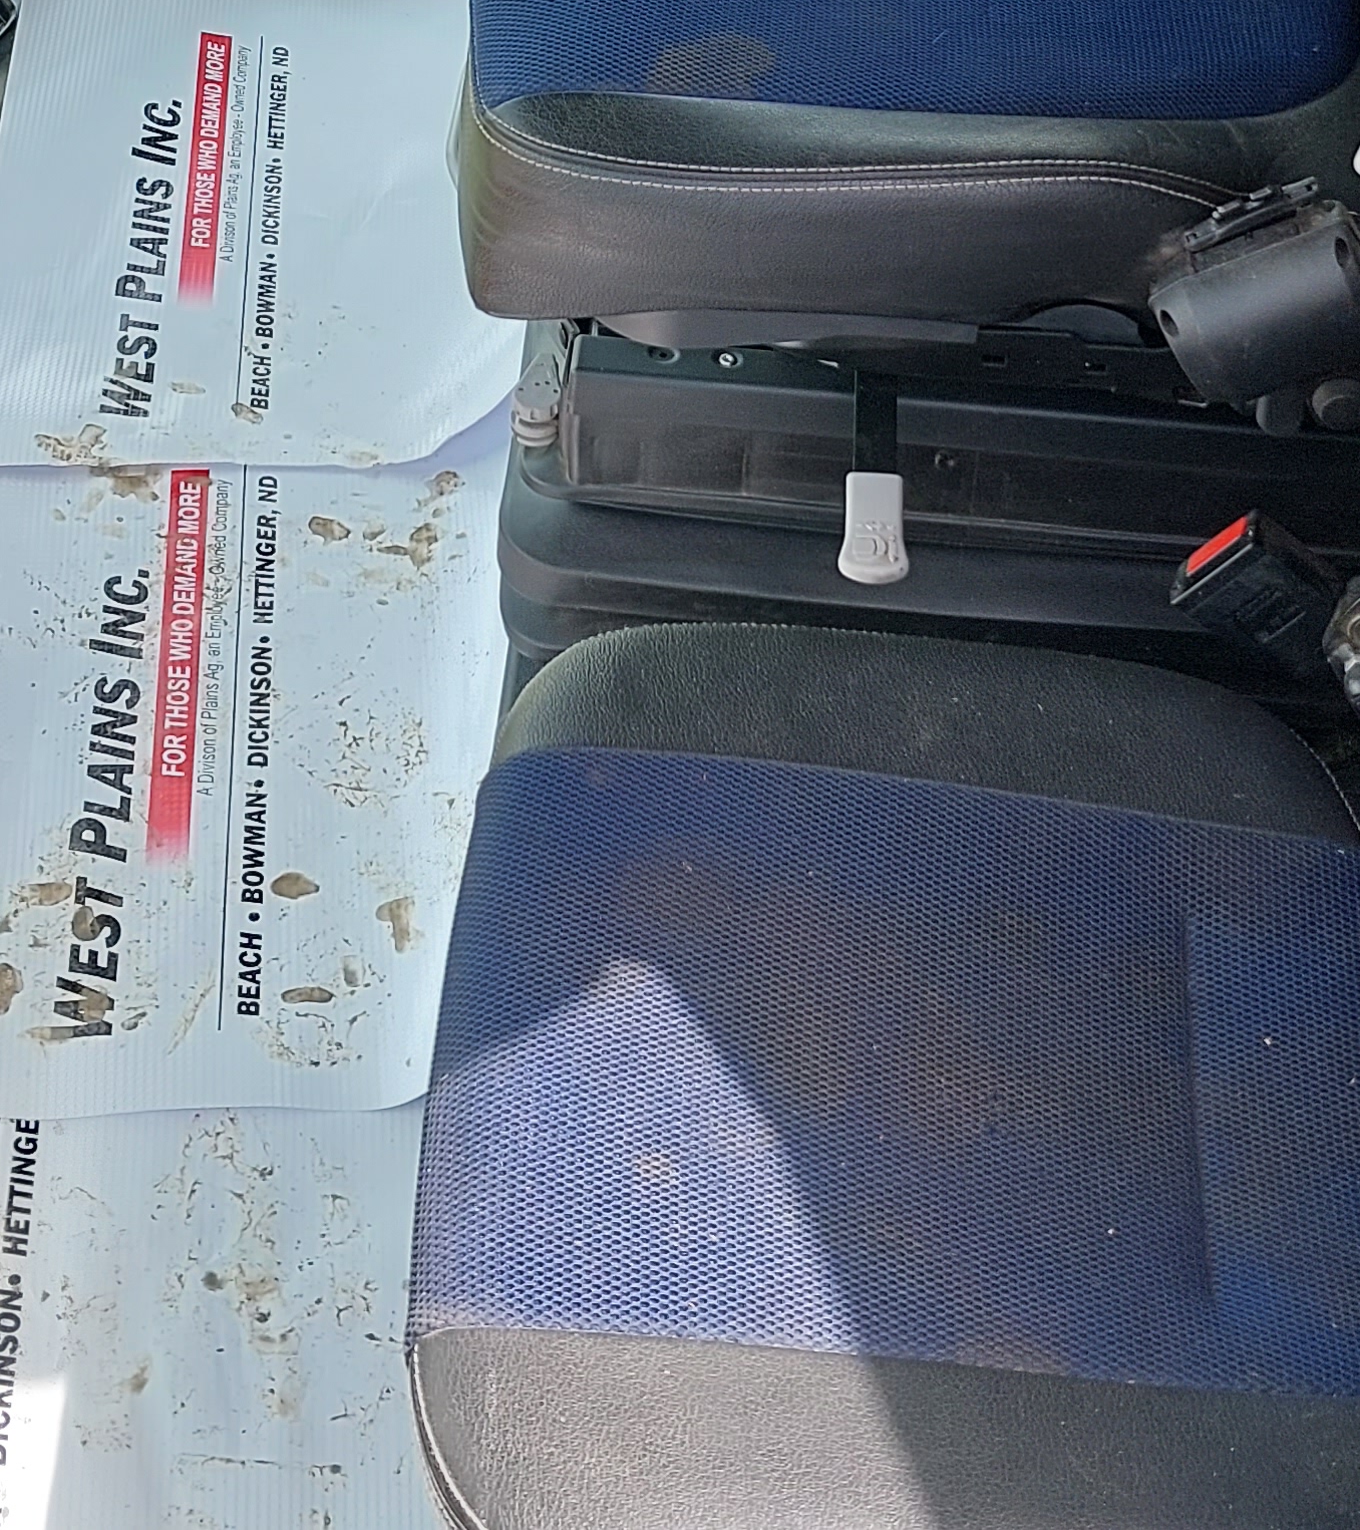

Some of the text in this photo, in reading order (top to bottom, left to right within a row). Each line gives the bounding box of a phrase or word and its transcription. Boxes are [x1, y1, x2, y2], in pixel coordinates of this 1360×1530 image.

[233, 44, 252, 83] Company
[231, 83, 245, 113] Owned
[190, 41, 226, 248] FOR THOSE WHO DEMAND MORE
[227, 122, 245, 159] Employee
[230, 159, 240, 171] an
[223, 181, 239, 210] Plains
[222, 210, 237, 219] of
[249, 46, 293, 410] BEACH BOWMAN DICKINSON HETTINGER, ND
[220, 219, 236, 250] Divison
[98, 99, 183, 418] WEST PLAINS INC.
[219, 250, 233, 262] A
[211, 479, 233, 532] Company
[208, 535, 226, 576] Owned
[161, 480, 202, 777] FOR THOSE WHO DEMAND MORE
[205, 585, 228, 640] Employee
[207, 643, 221, 657] an
[203, 658, 224, 681] Ag,
[201, 684, 220, 720] Plains
[200, 722, 217, 736] of
[237, 475, 282, 1016] BEACH BOWMAN DICKINSON HETTINGER, ND
[197, 737, 216, 785] Divison
[50, 568, 150, 1037] WEST PLAINS INC.
[196, 787, 213, 797] A
